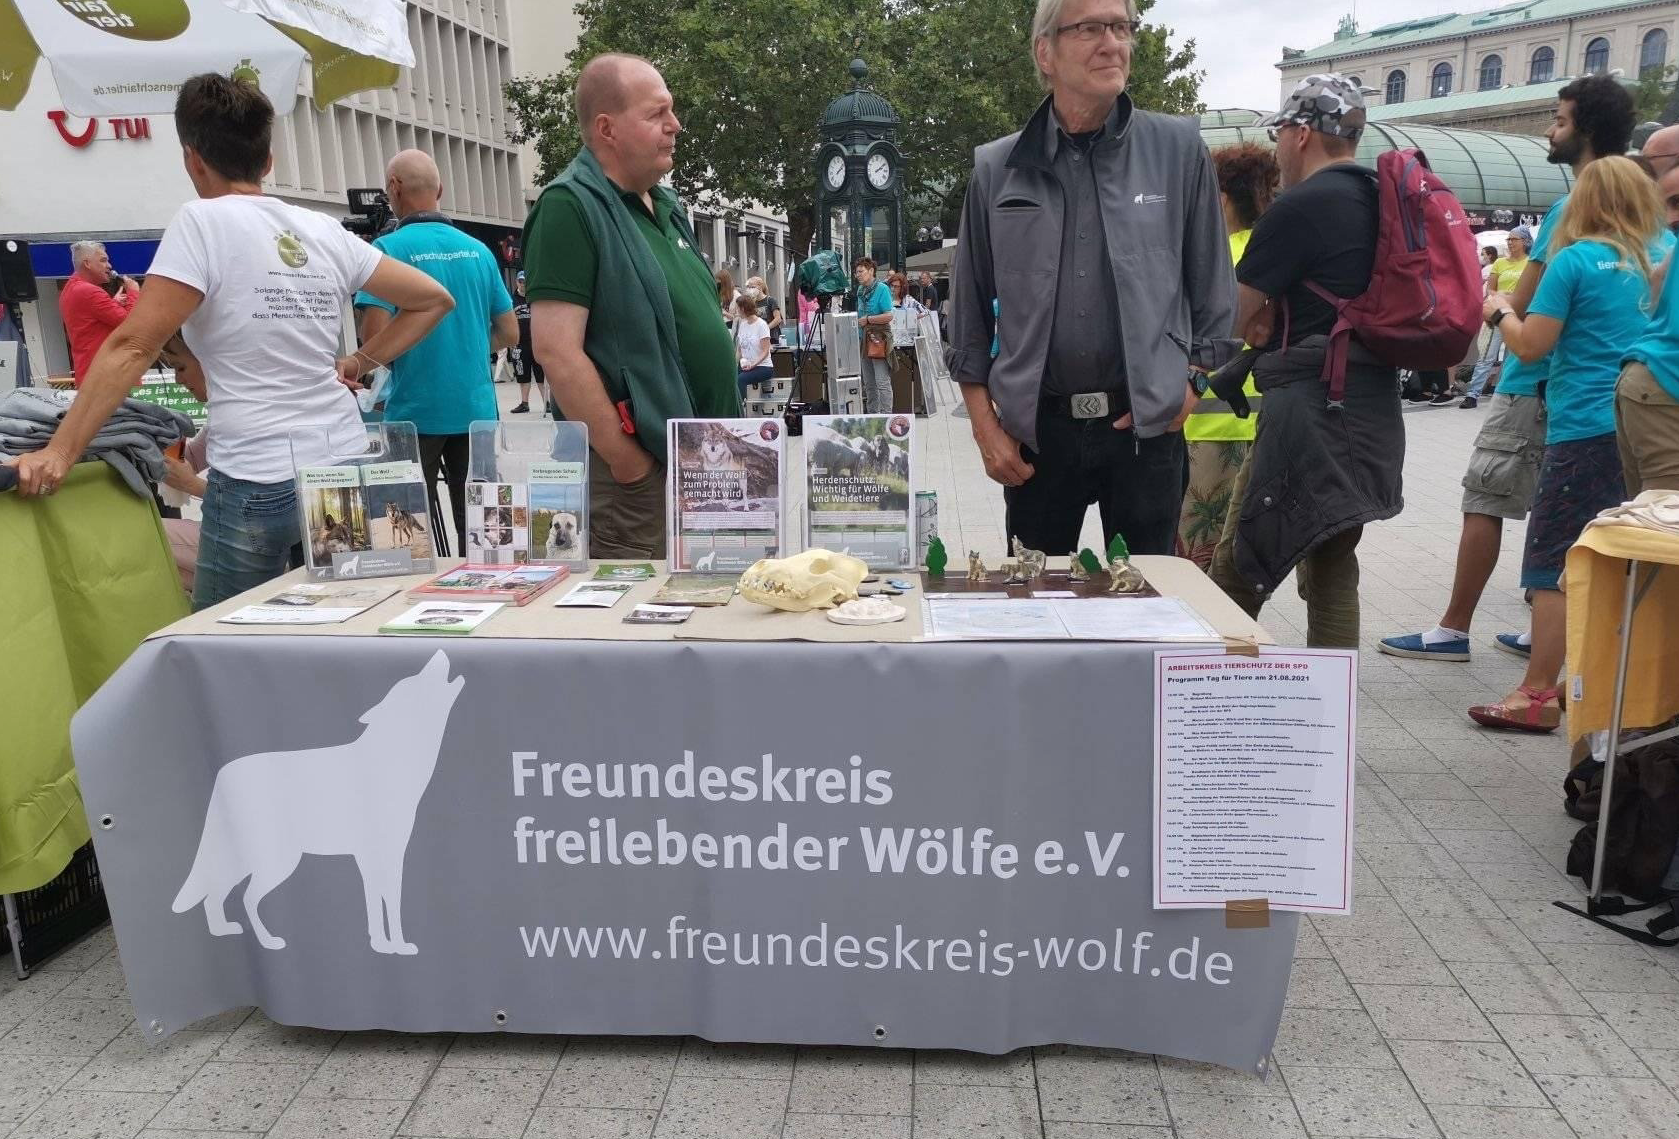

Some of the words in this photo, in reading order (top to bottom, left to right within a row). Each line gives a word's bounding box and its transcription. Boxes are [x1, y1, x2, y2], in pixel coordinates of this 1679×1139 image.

[108, 118, 152, 139] TUI
[410, 250, 479, 262] tierschutzpartei.de
[254, 286, 284, 296] Solange
[155, 386, 170, 394] ist
[156, 397, 178, 406] Tier
[683, 471, 709, 479] Wenn
[710, 470, 724, 479] der
[725, 470, 746, 479] Wolf
[703, 479, 739, 488] Problem
[812, 476, 876, 484] Herdenschutz:
[684, 489, 721, 499] gemacht
[722, 489, 742, 498] wird
[812, 485, 847, 495] Wichtig
[848, 485, 862, 493] für
[863, 484, 890, 493] Wölfe
[812, 494, 829, 503] und
[831, 494, 880, 503] Weidetiere
[1224, 662, 1273, 670] TIERSCHUTZ
[1167, 676, 1204, 684] Programm
[1206, 675, 1220, 683] Tag
[1268, 674, 1310, 682] 21.08.2021
[510, 749, 893, 807] Freundeskreis
[513, 815, 849, 872] freilebender
[859, 825, 1019, 880] Wölfe
[1034, 830, 1132, 879] e.V.
[518, 914, 1234, 987] www.freundeskreis-wolf.de
